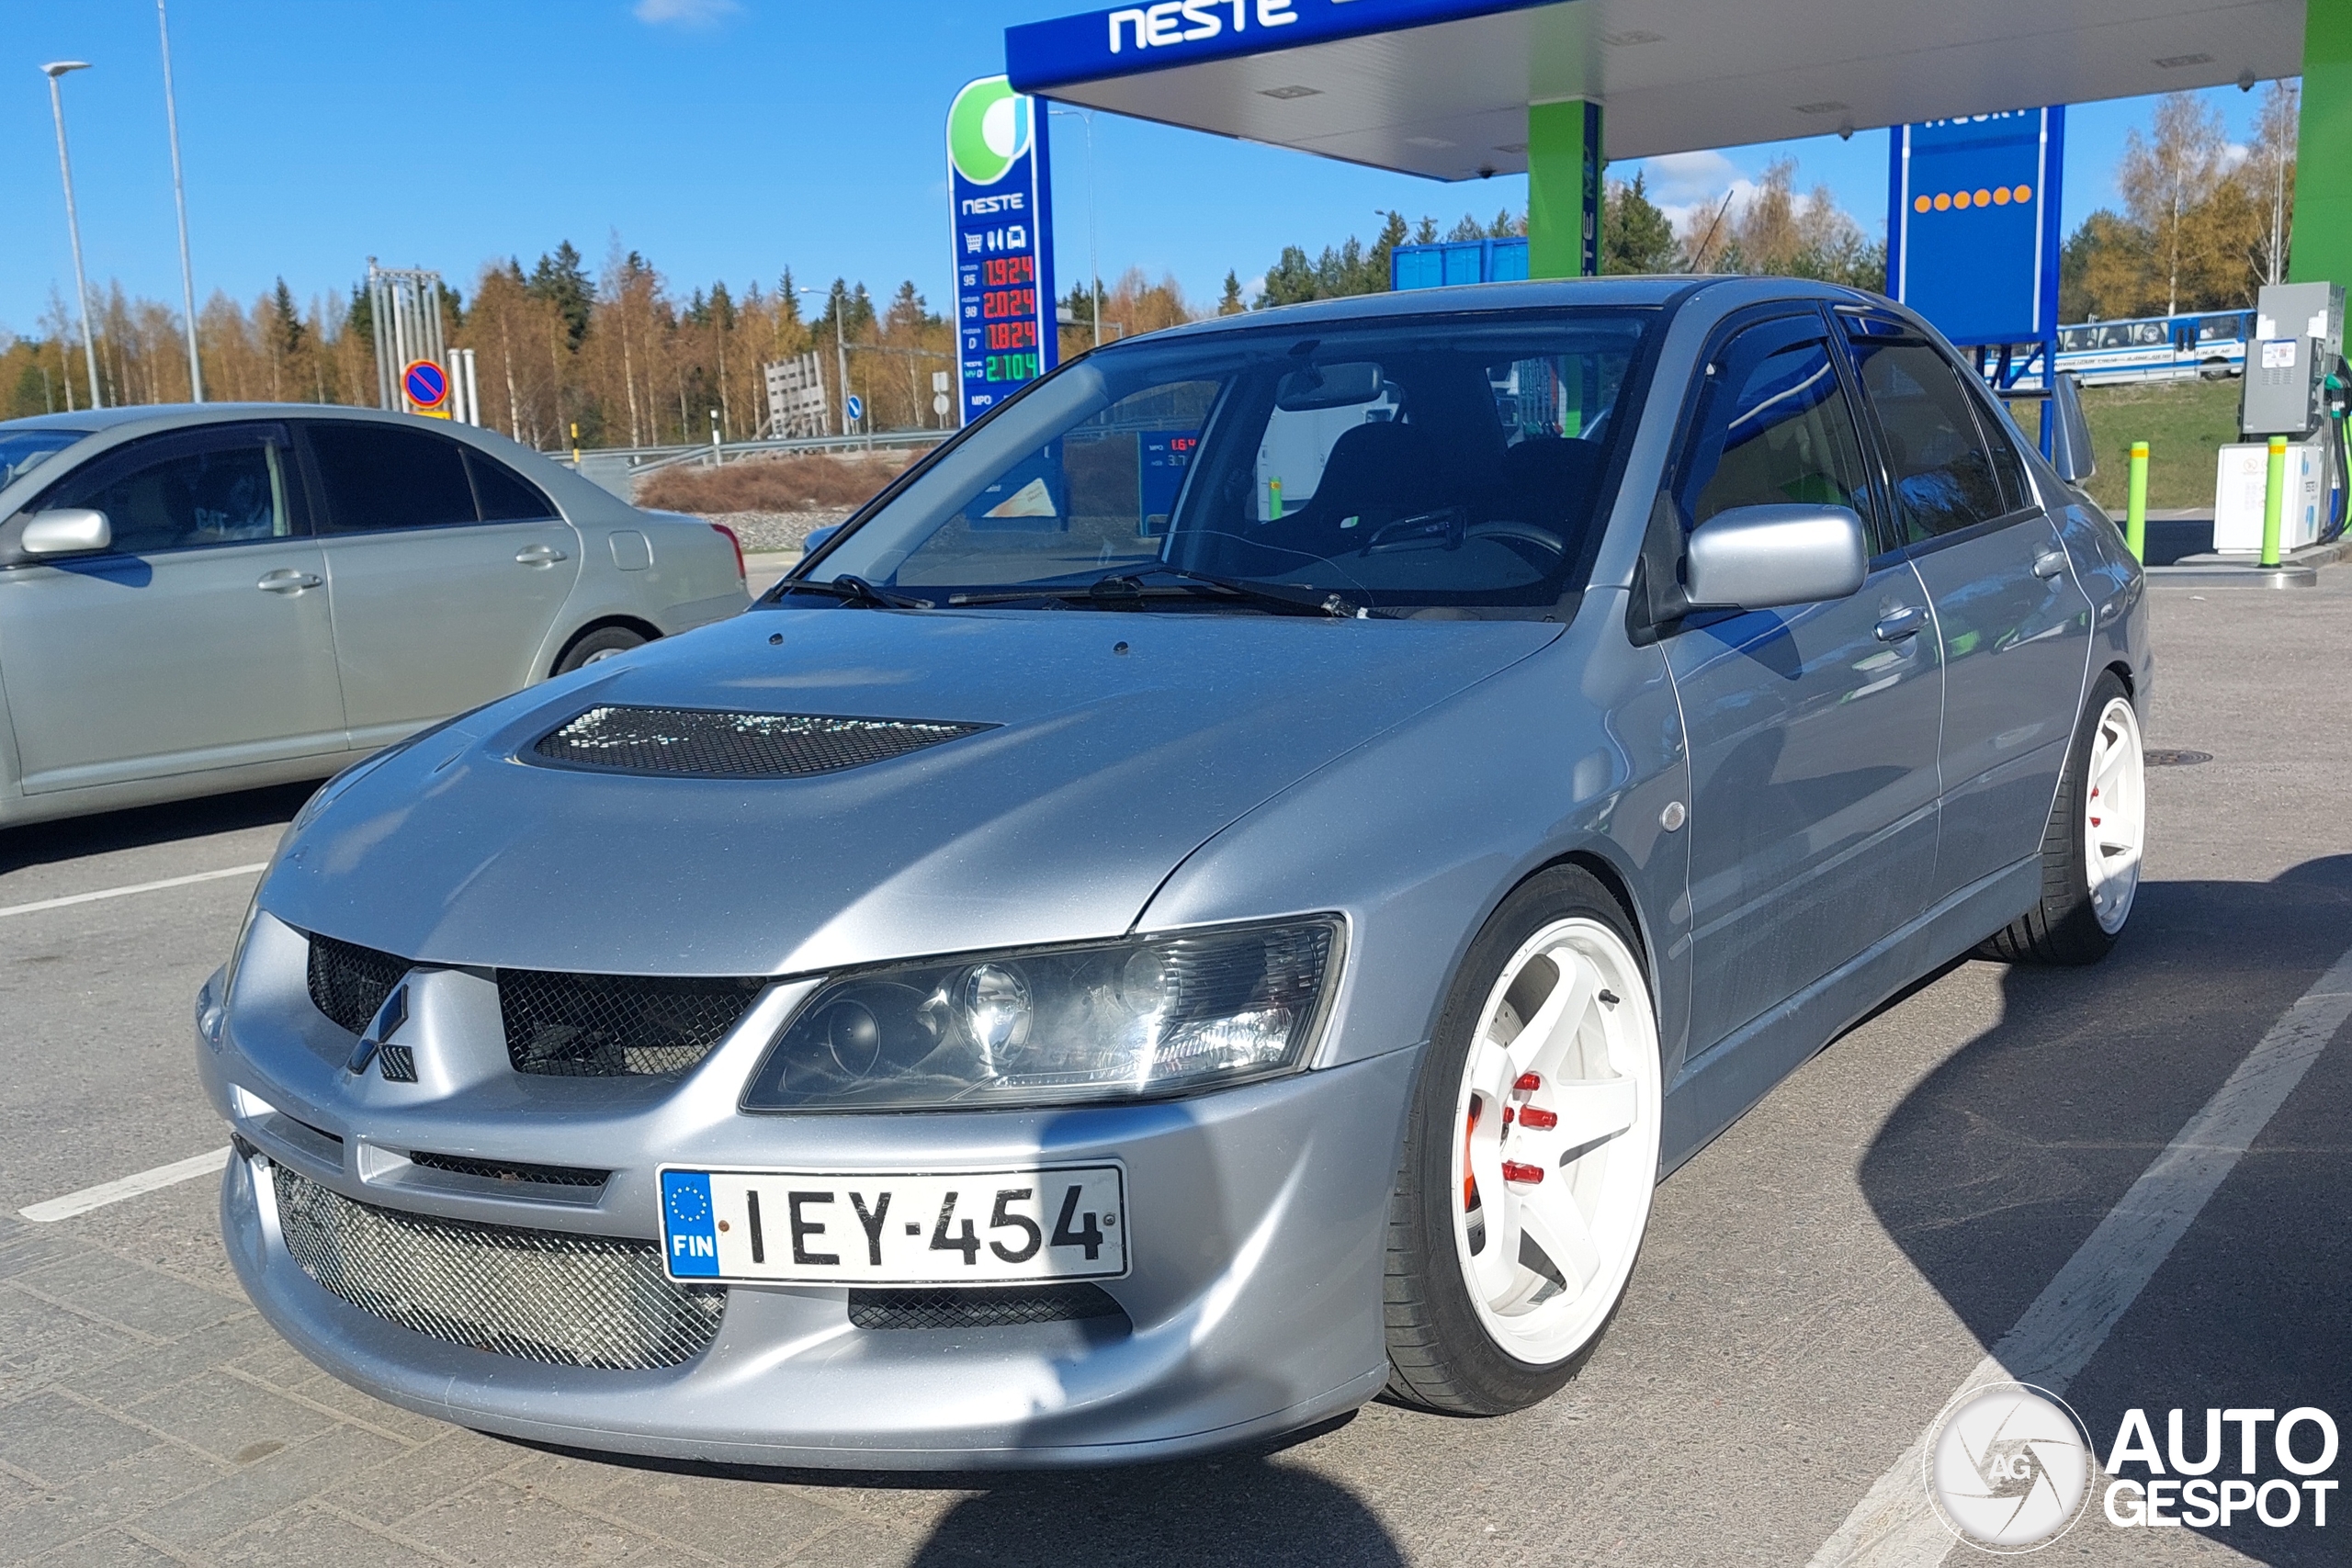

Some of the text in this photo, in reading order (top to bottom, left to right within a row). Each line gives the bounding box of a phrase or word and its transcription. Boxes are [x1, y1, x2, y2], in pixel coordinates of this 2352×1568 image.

[1109, 0, 1298, 53] NESTE
[962, 192, 1024, 216] NESTE
[986, 255, 1035, 287] 1.924
[983, 288, 1035, 319] 2.024
[968, 337, 978, 349] D
[986, 353, 1037, 382] 2.104
[746, 1185, 1103, 1266] IEY-454
[673, 1235, 714, 1258] FIN
